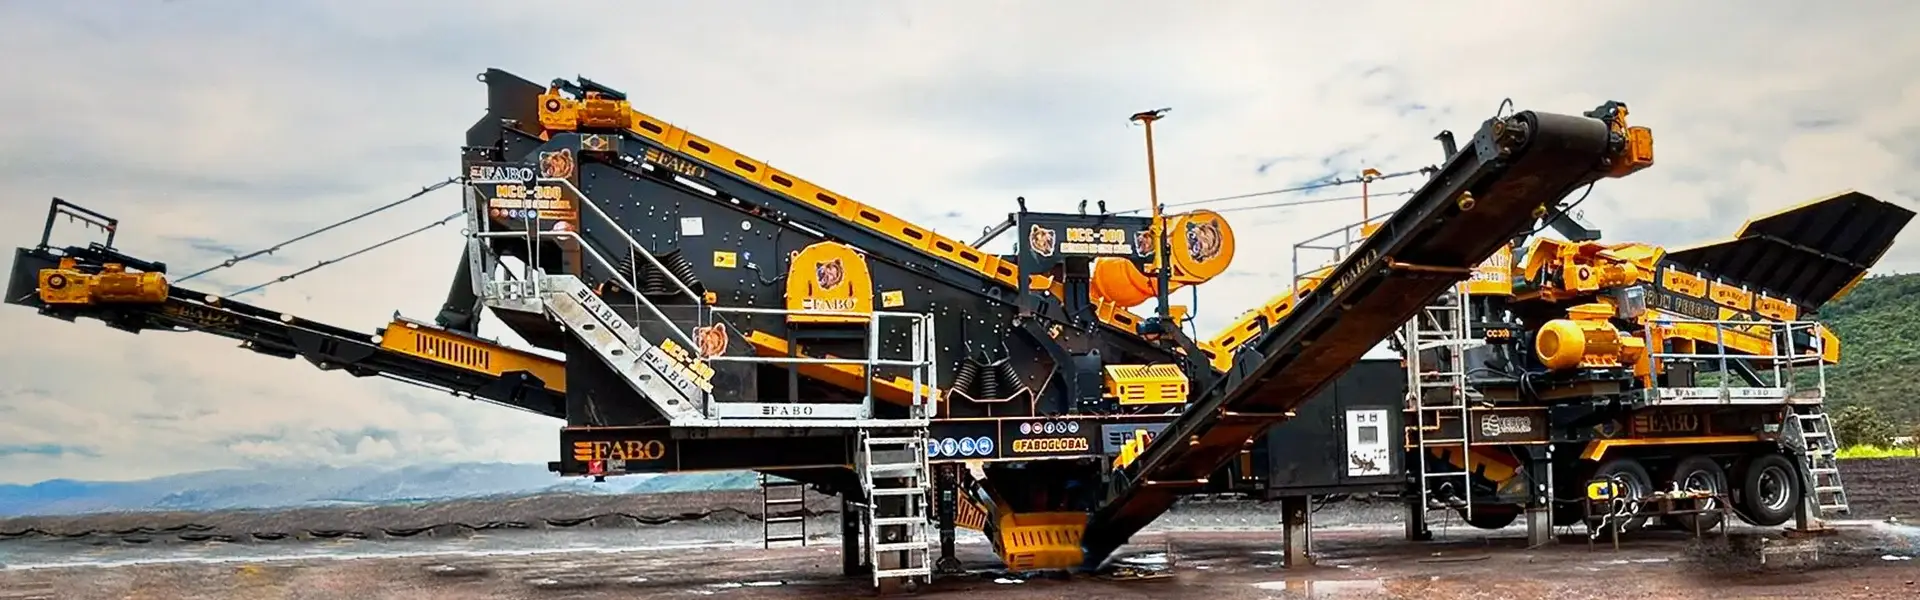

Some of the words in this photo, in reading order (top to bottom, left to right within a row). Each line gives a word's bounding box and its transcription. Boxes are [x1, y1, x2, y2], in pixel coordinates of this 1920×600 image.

[481, 167, 534, 181] FABO
[585, 294, 623, 331] FABO
[813, 298, 855, 311] FABO
[652, 355, 689, 390] FABO
[770, 405, 813, 416] FABO
[1652, 415, 1700, 433] FABO
[592, 439, 665, 461] FABO
[1013, 436, 1089, 453] #FABOGLOBAL
